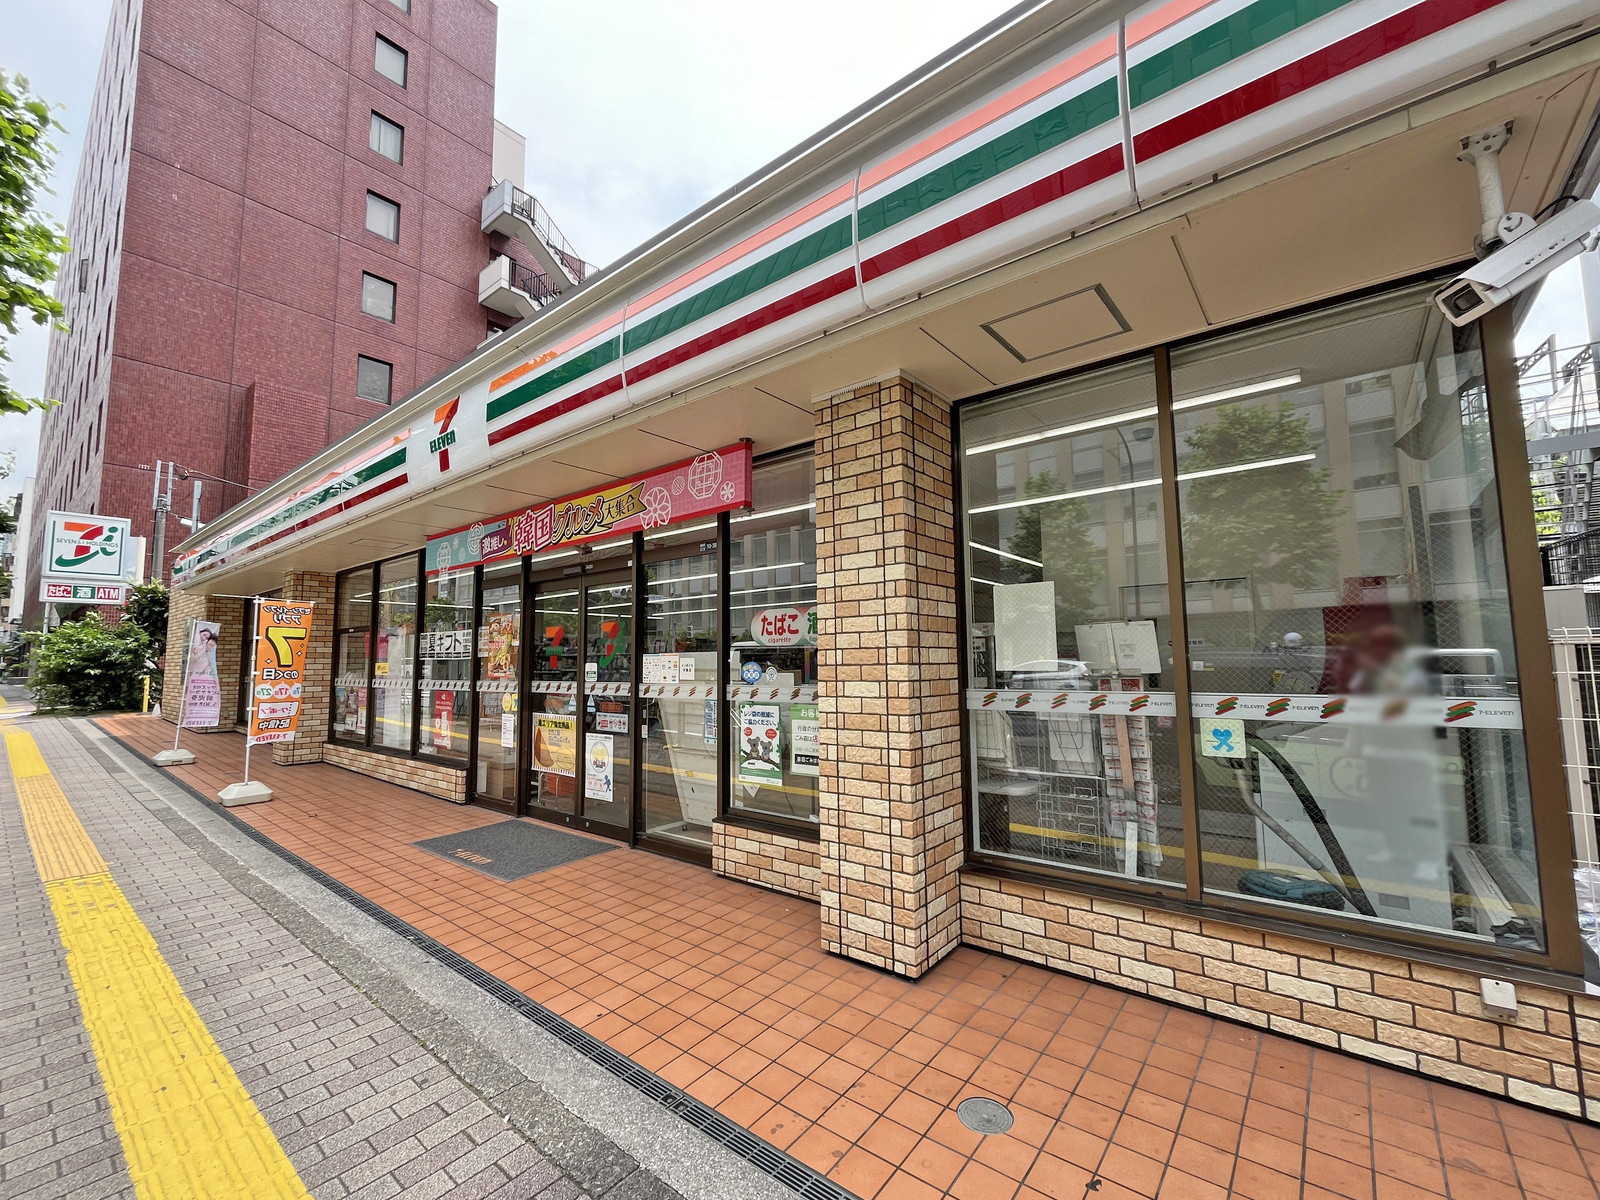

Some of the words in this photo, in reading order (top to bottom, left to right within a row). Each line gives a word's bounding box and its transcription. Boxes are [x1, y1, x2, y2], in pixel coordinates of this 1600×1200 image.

[433, 395, 460, 472] 7
[513, 505, 554, 554] 韓国
[552, 497, 603, 544] グルメ
[605, 494, 637, 521] 大集合
[48, 585, 71, 598] たばこ
[76, 586, 93, 599] 酒
[97, 588, 119, 600] ATM
[761, 612, 799, 637] たばこ
[428, 632, 462, 652] 夏ギフト
